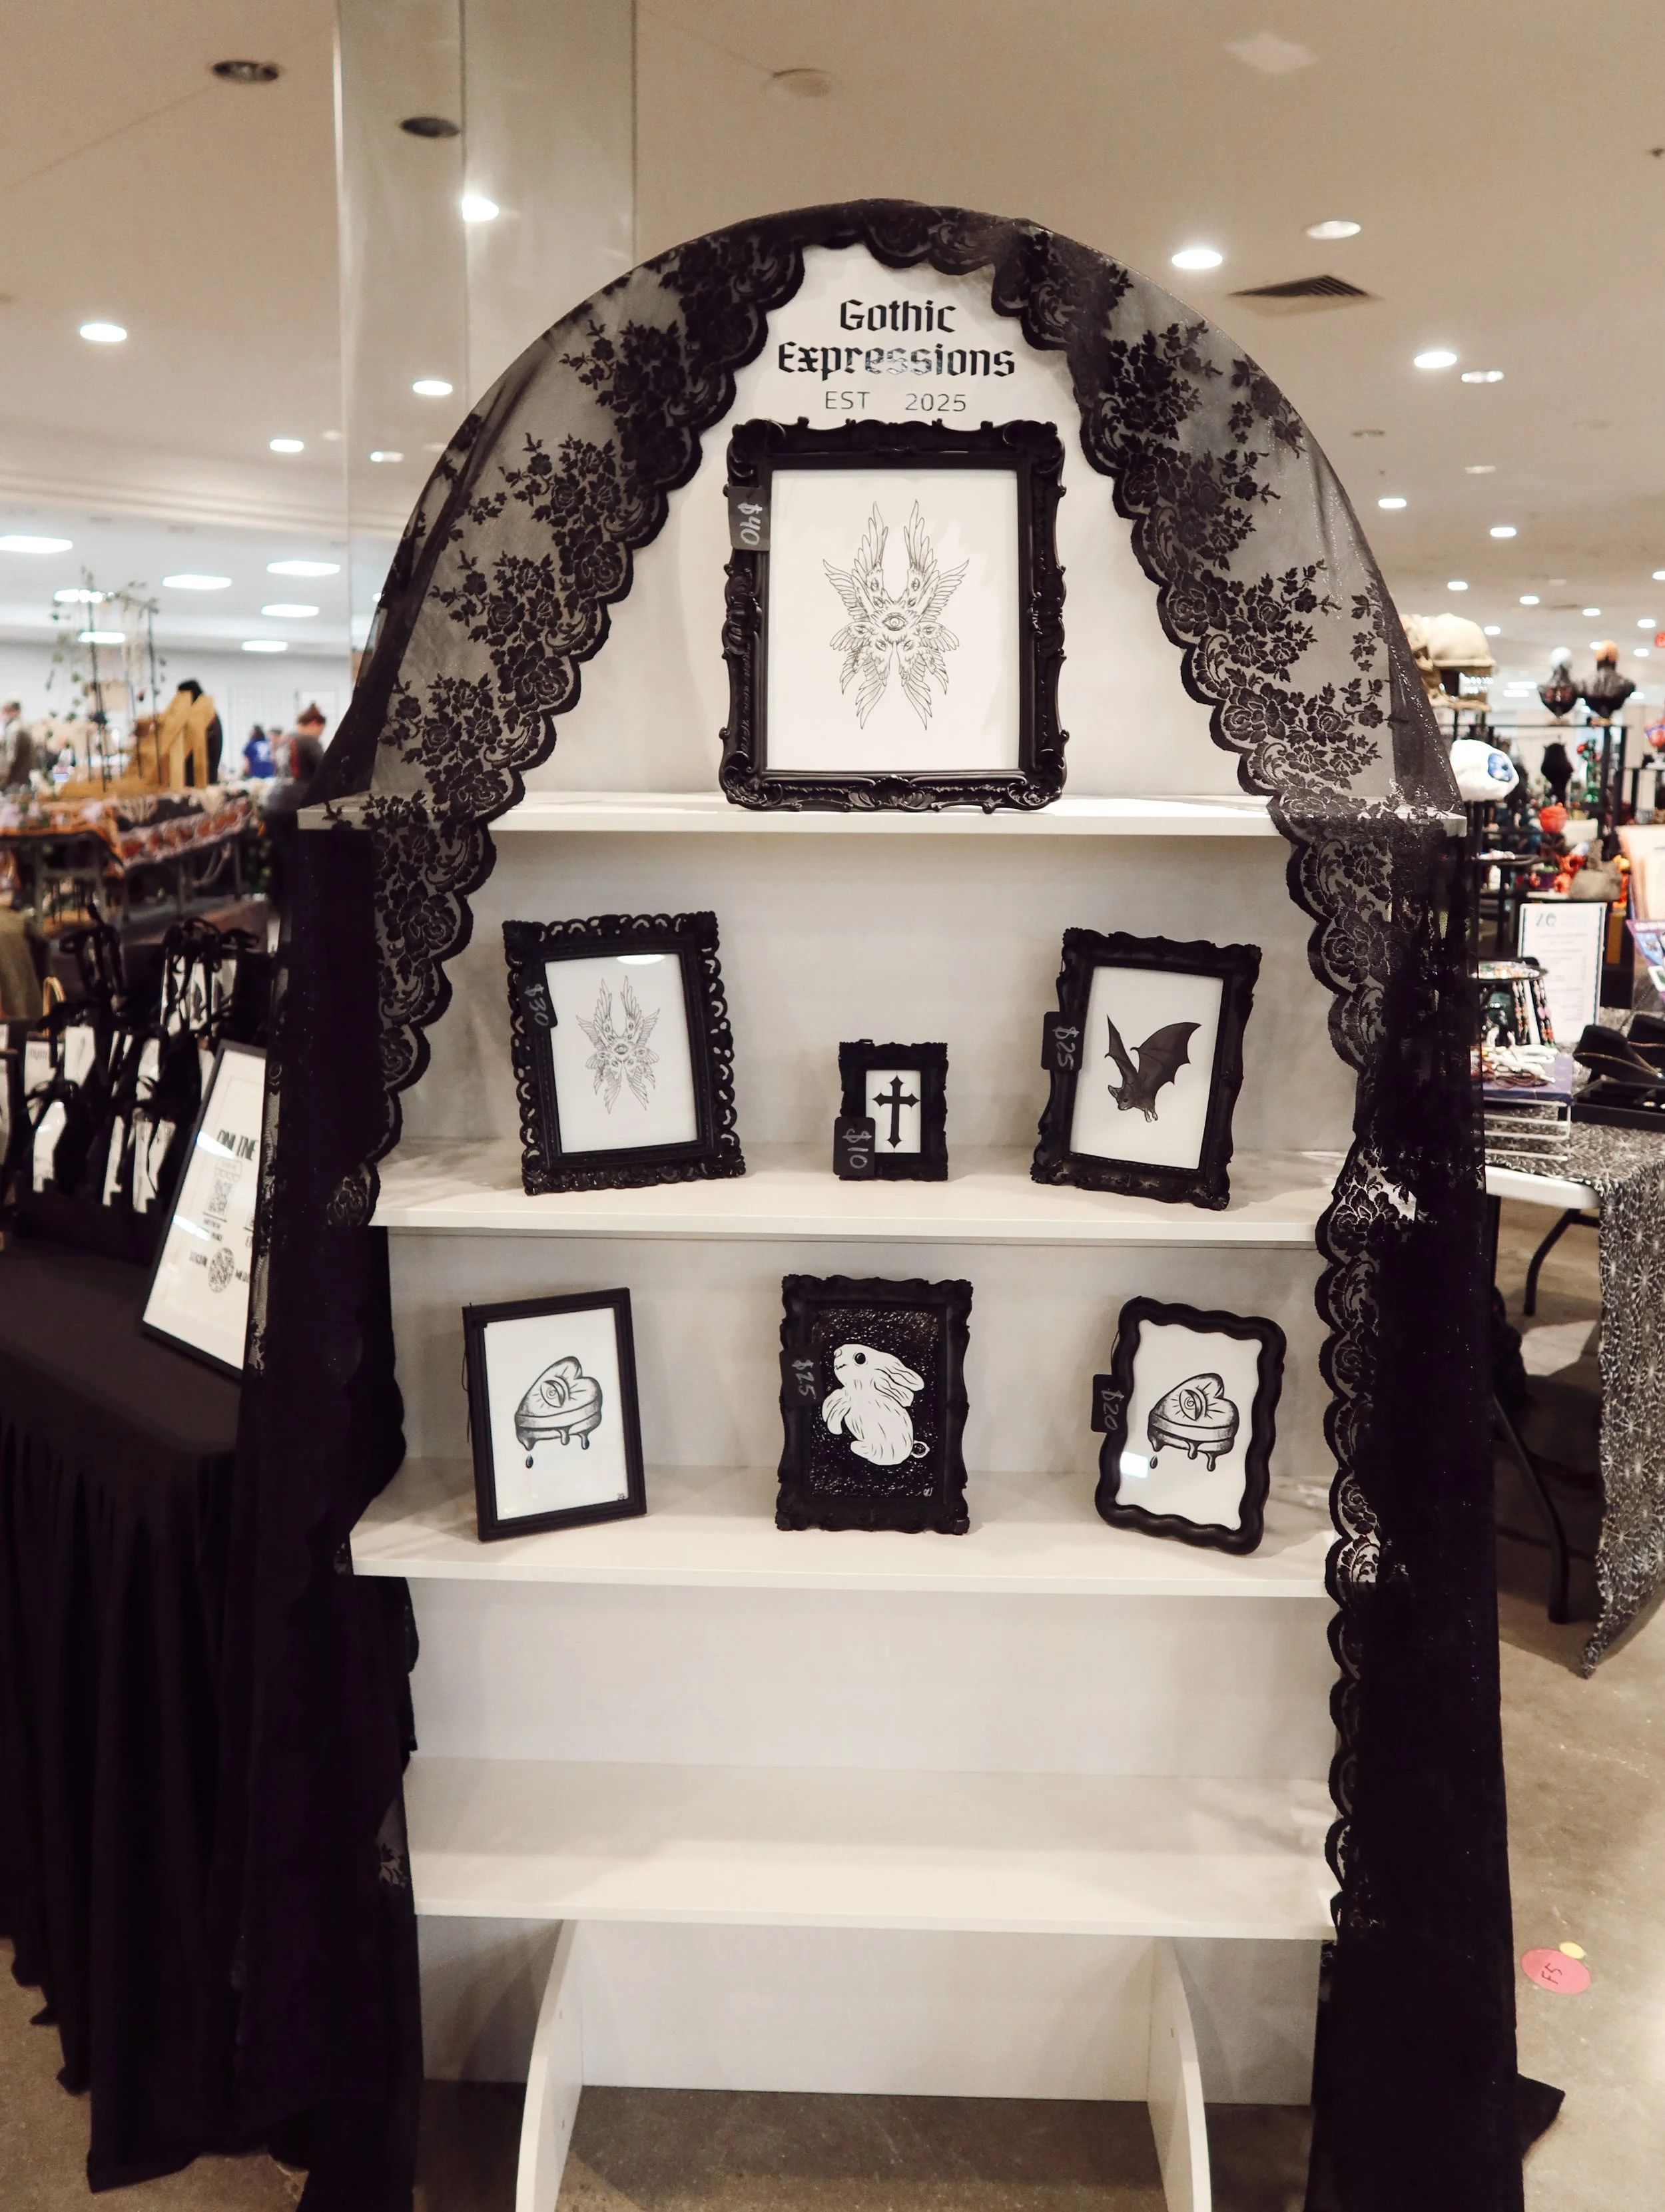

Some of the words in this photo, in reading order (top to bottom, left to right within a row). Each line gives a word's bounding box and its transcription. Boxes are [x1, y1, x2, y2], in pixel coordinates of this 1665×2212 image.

[840, 298, 957, 334] Gothic
[778, 340, 1016, 382] Expressions
[825, 391, 870, 410] EST
[904, 393, 966, 412] 2025
[737, 501, 763, 545] $40
[524, 983, 549, 1026] $30
[1052, 1025, 1080, 1071] $25
[842, 1128, 872, 1169] $10
[791, 1359, 817, 1400] $25
[1100, 1389, 1125, 1431] $20
[1541, 1962, 1562, 1985] F5
